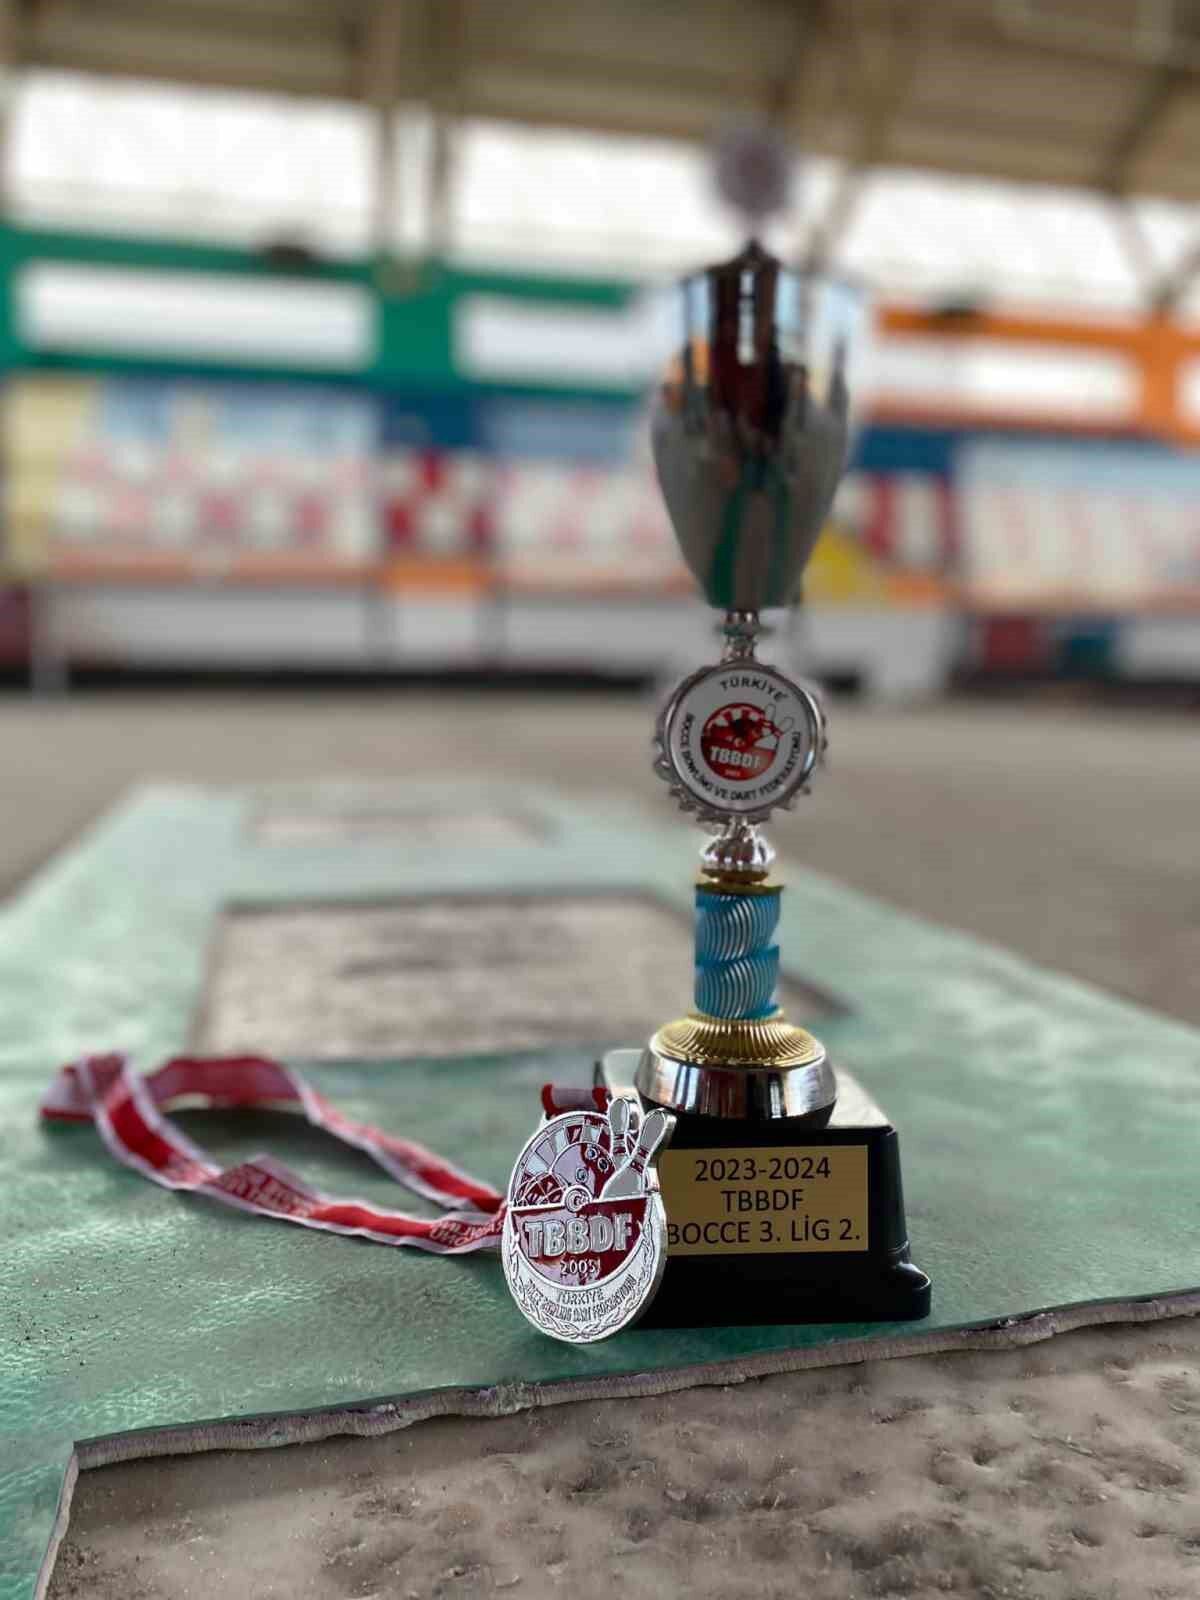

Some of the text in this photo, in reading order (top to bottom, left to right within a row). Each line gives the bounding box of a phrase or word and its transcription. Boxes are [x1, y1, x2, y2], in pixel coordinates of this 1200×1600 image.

[719, 675, 787, 701] TÜRKİYE
[714, 786, 729, 800] VE
[730, 789, 758, 801] DART
[695, 1156, 831, 1182] 2023-2024
[721, 1188, 804, 1213] TBBDF
[524, 1212, 632, 1258] TBBDF
[667, 1215, 861, 1245] BOCCE 3. LİG 2.
[557, 1288, 605, 1305] TÜRKİYE
